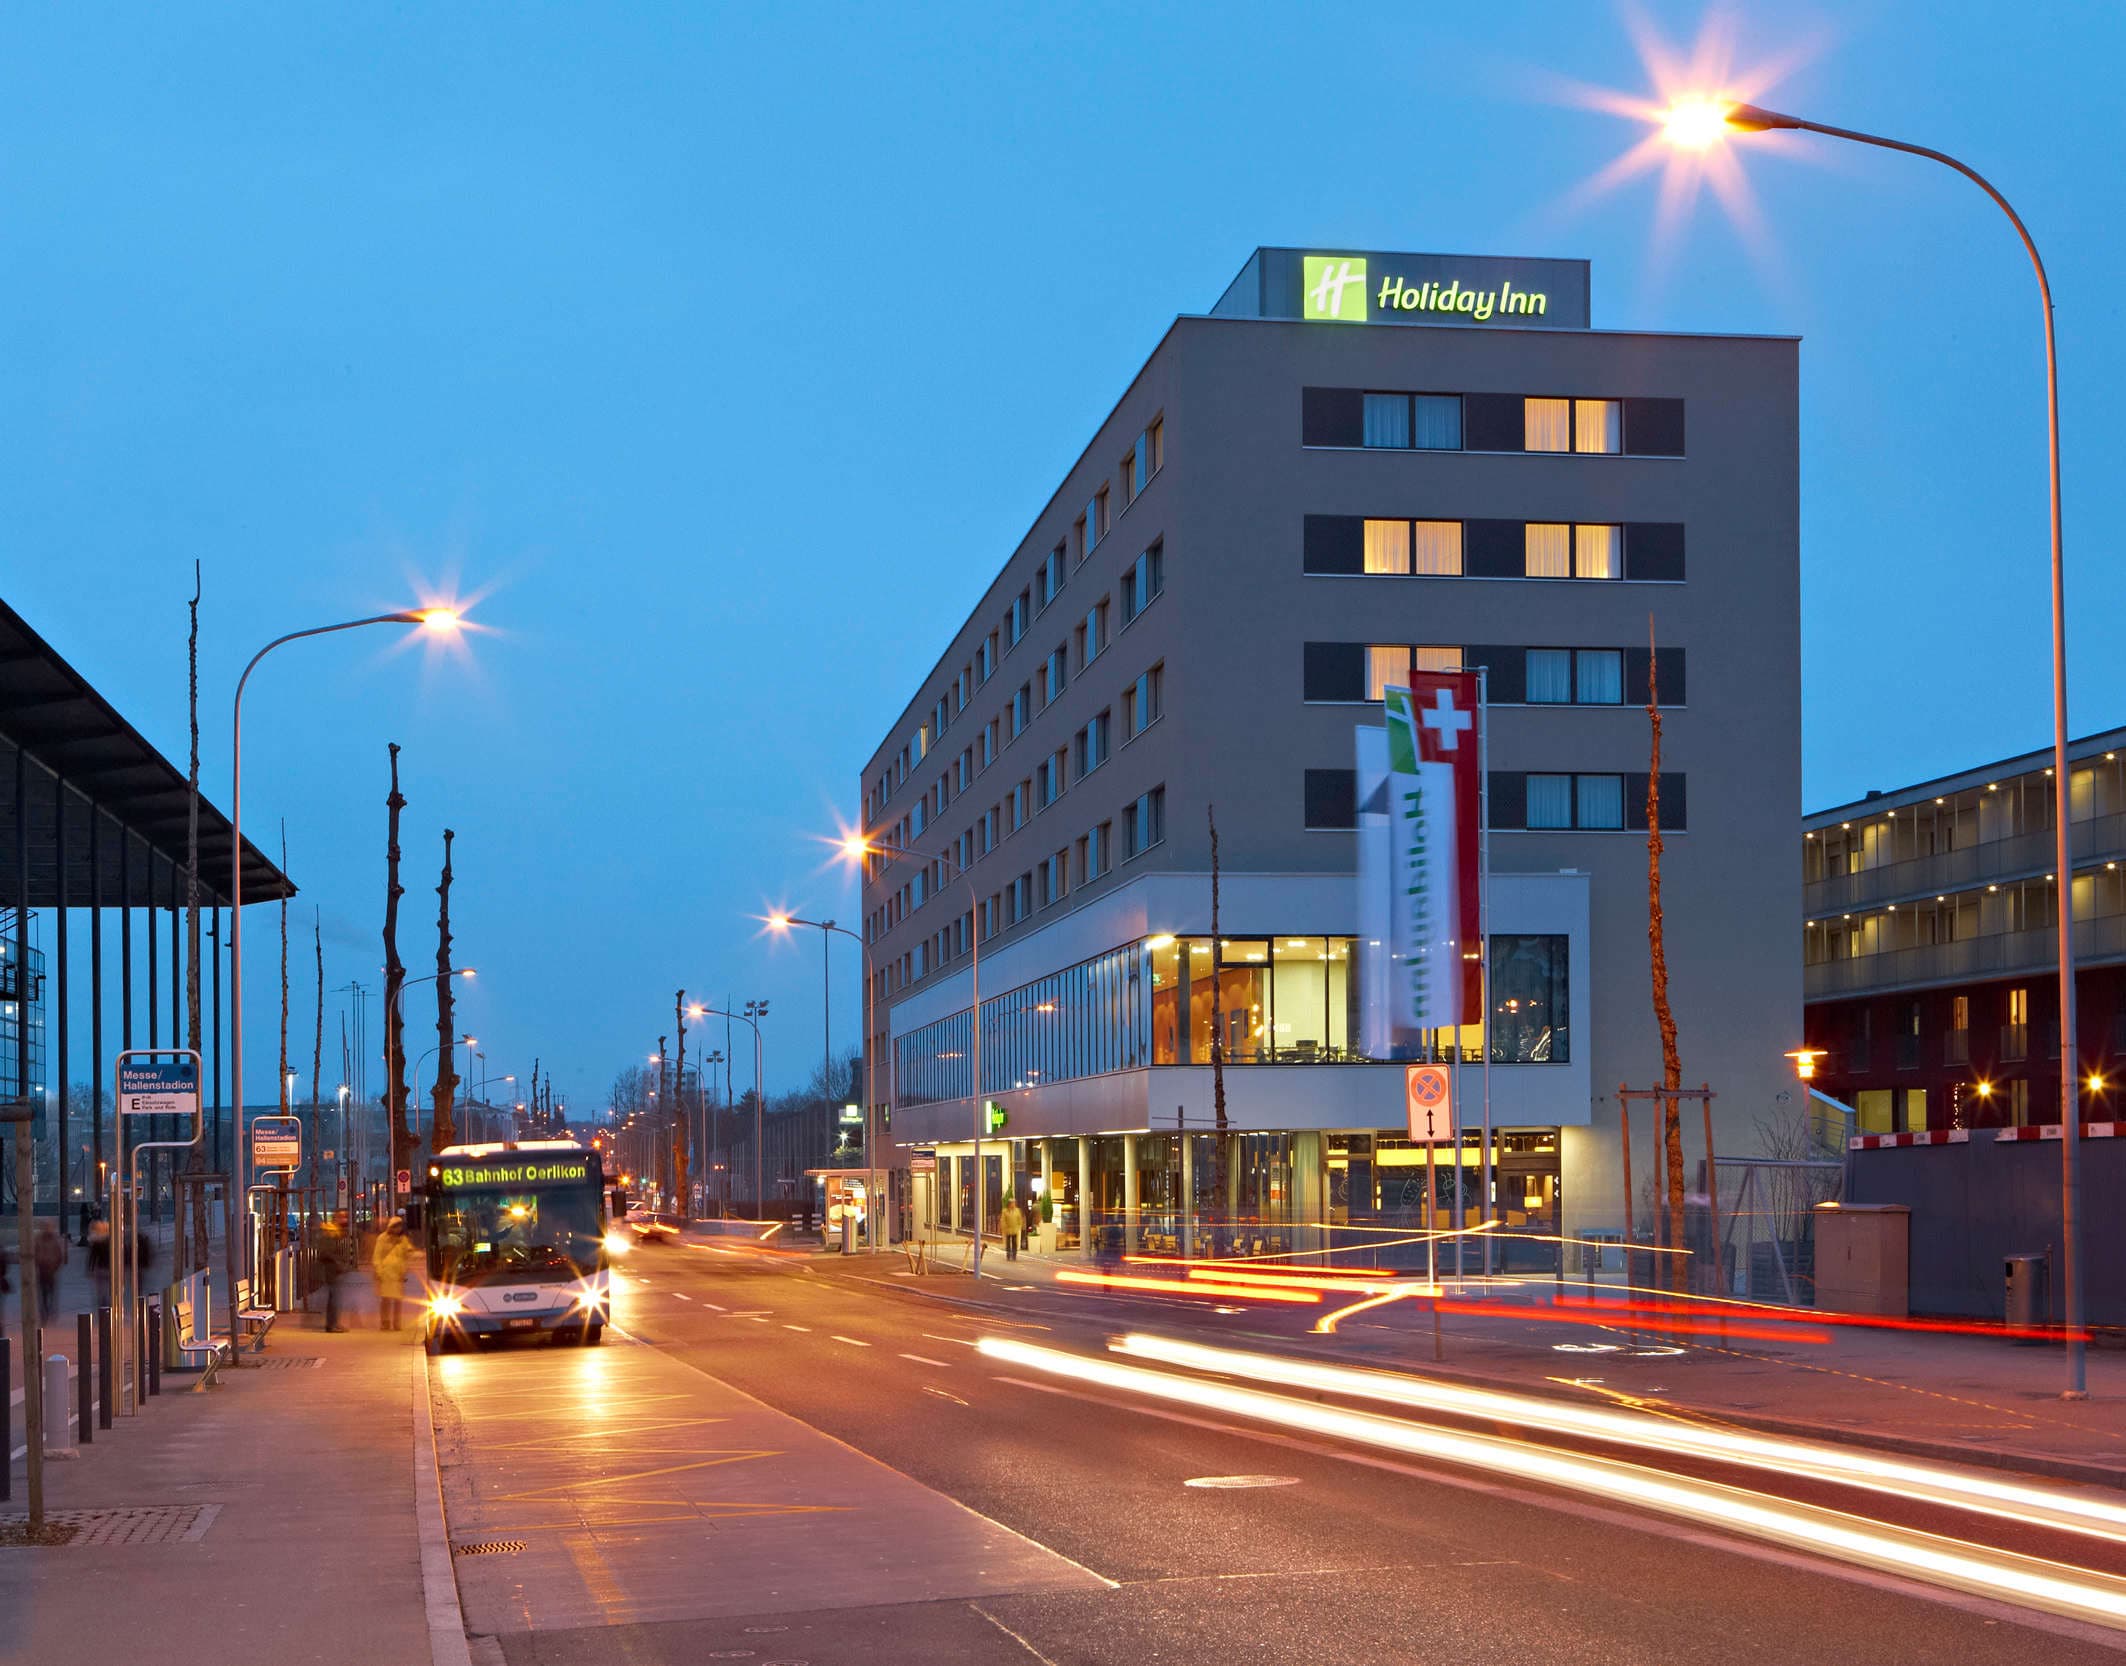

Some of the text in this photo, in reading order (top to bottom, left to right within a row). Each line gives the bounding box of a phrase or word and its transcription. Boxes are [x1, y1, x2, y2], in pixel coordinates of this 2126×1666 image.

[1377, 276, 1546, 321] Holiday Inn
[123, 1069, 163, 1080] Messe/
[123, 1080, 194, 1091] Hallenstadion
[131, 1098, 141, 1110] E
[255, 1145, 266, 1153] 63
[442, 1164, 586, 1187] 63 Bahnhof Oerlikon
